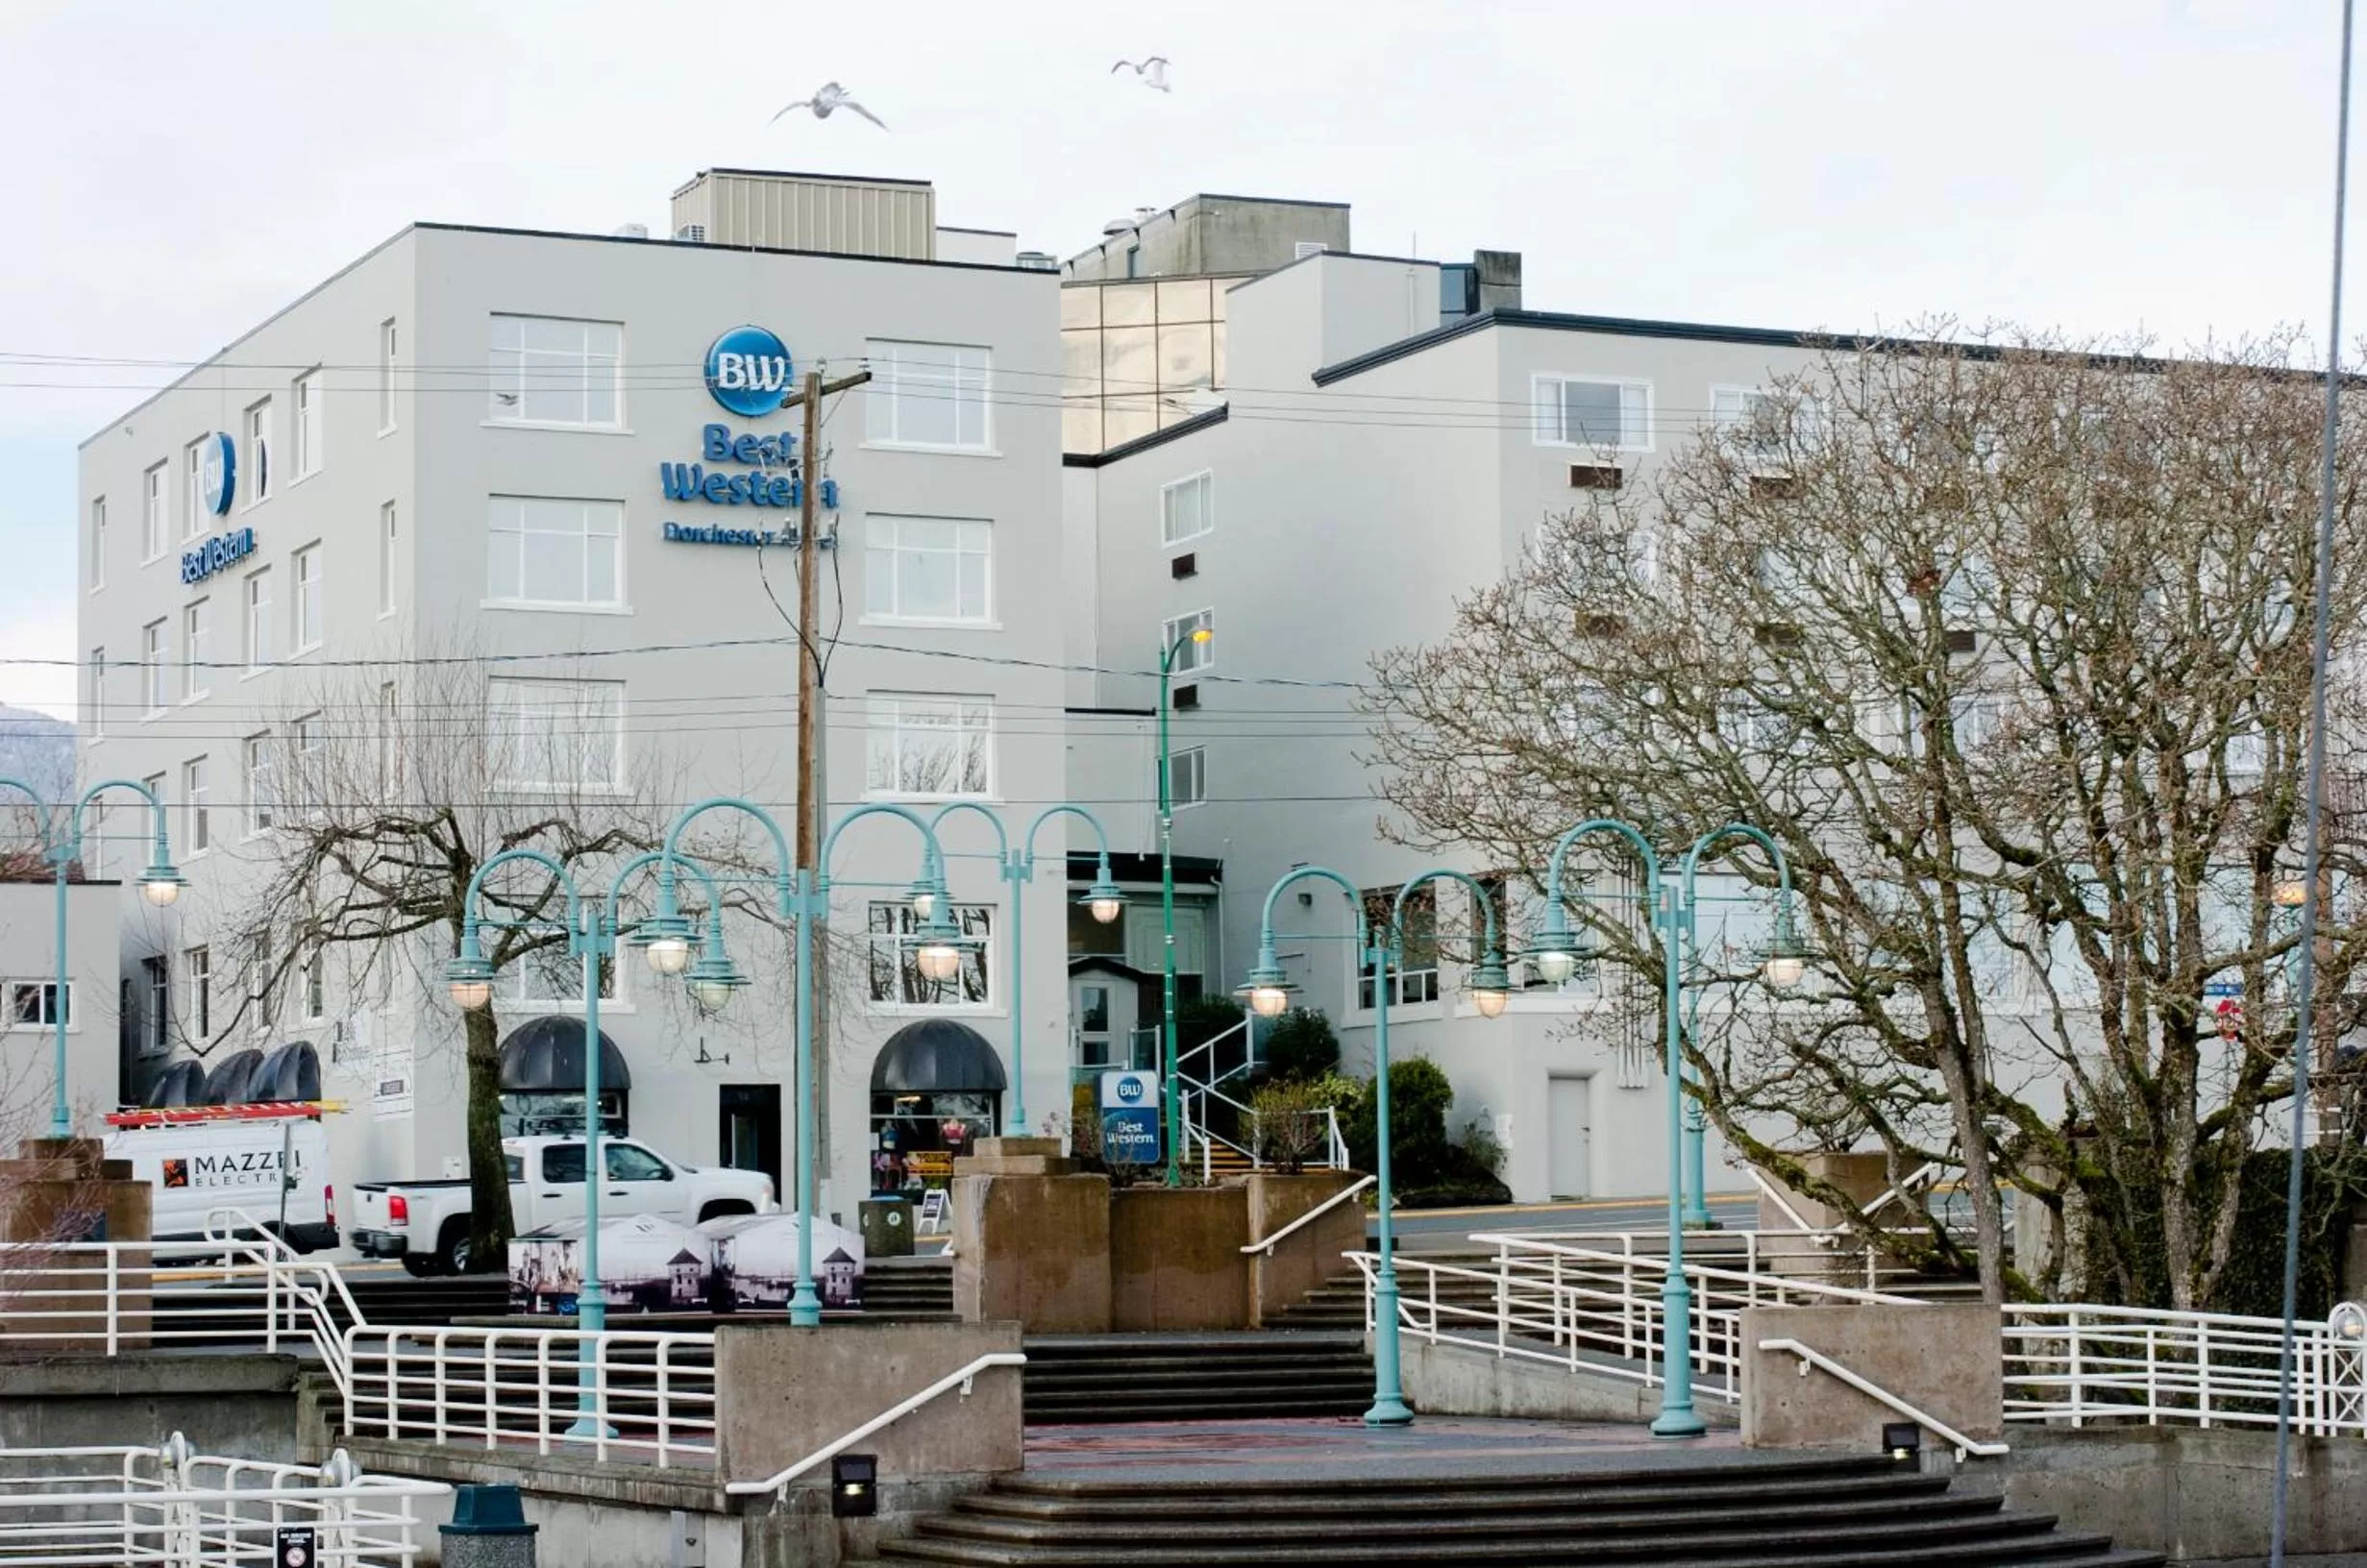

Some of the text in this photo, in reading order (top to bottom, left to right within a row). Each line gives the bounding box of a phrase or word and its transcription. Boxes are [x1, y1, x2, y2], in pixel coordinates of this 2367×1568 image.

[720, 353, 787, 391] BW
[703, 424, 798, 464] Best
[1120, 1084, 1141, 1096] BW
[1118, 1121, 1144, 1133] Best
[1107, 1134, 1153, 1143] Western
[195, 1170, 302, 1187] ELECTRC
